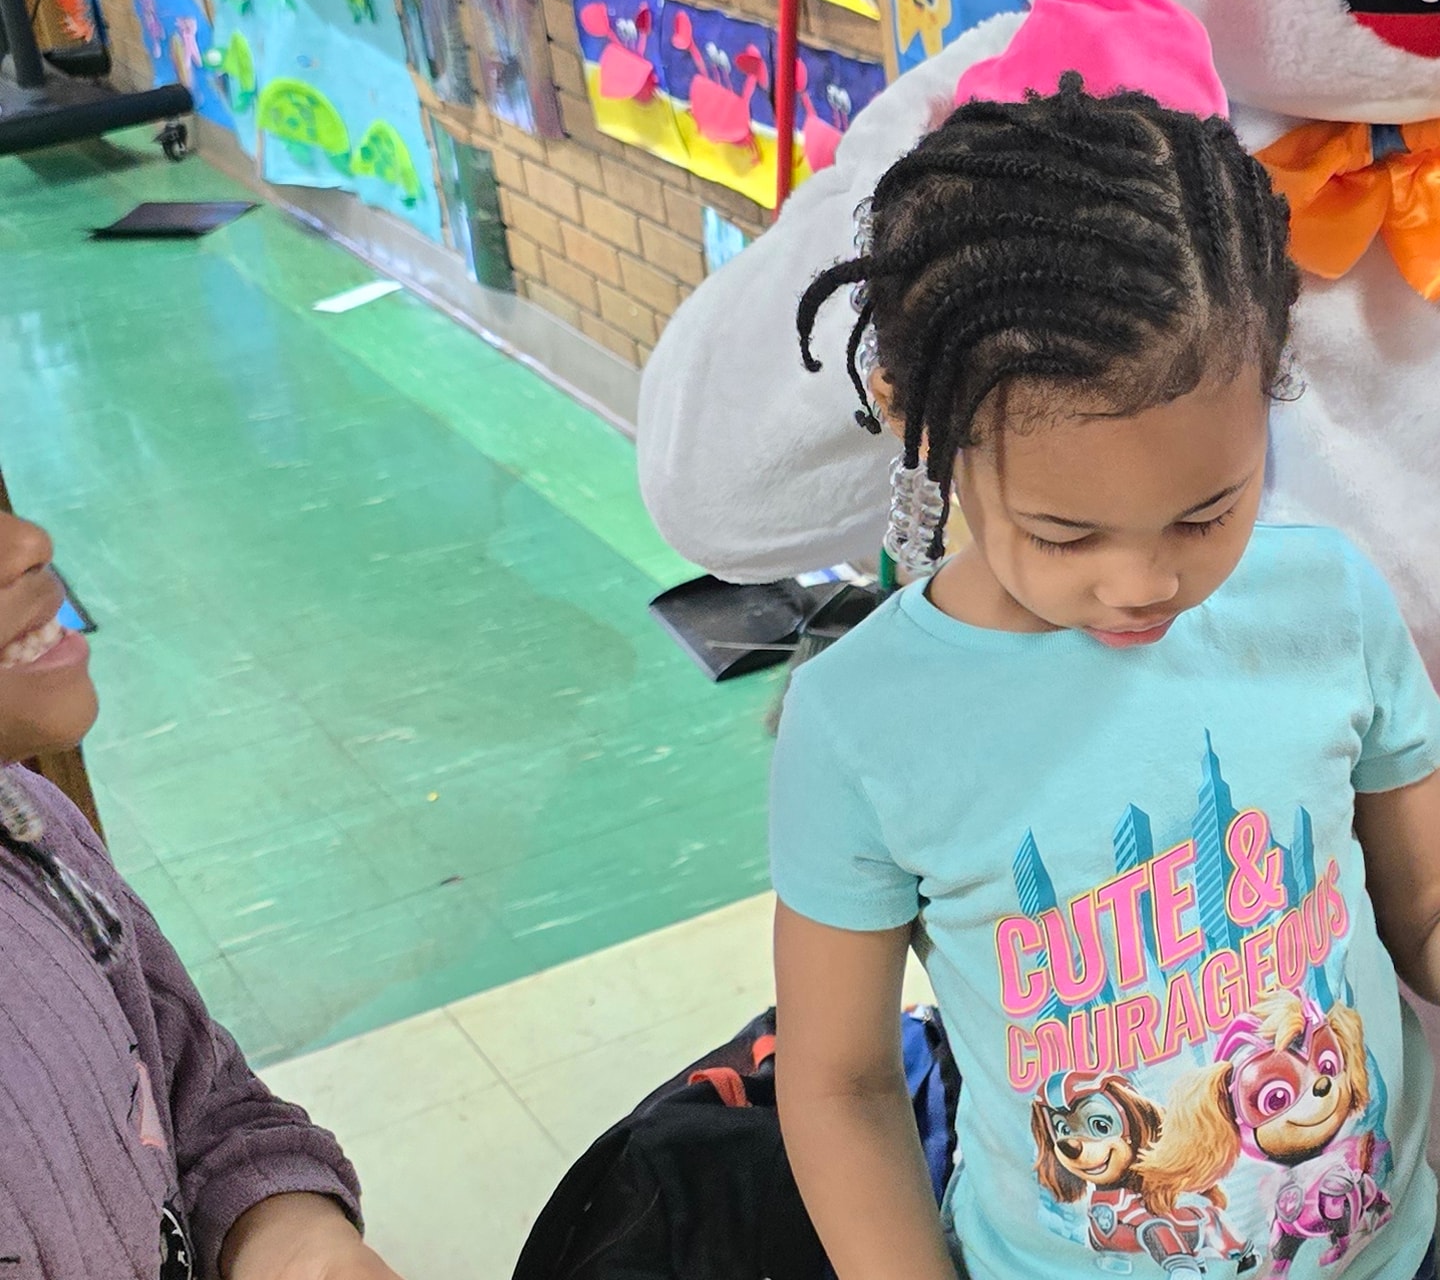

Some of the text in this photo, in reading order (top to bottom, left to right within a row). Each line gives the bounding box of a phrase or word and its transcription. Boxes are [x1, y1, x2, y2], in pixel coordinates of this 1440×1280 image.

[995, 808, 1288, 1020] CUTE &
[1005, 859, 1351, 1094] COURAGEOUS
